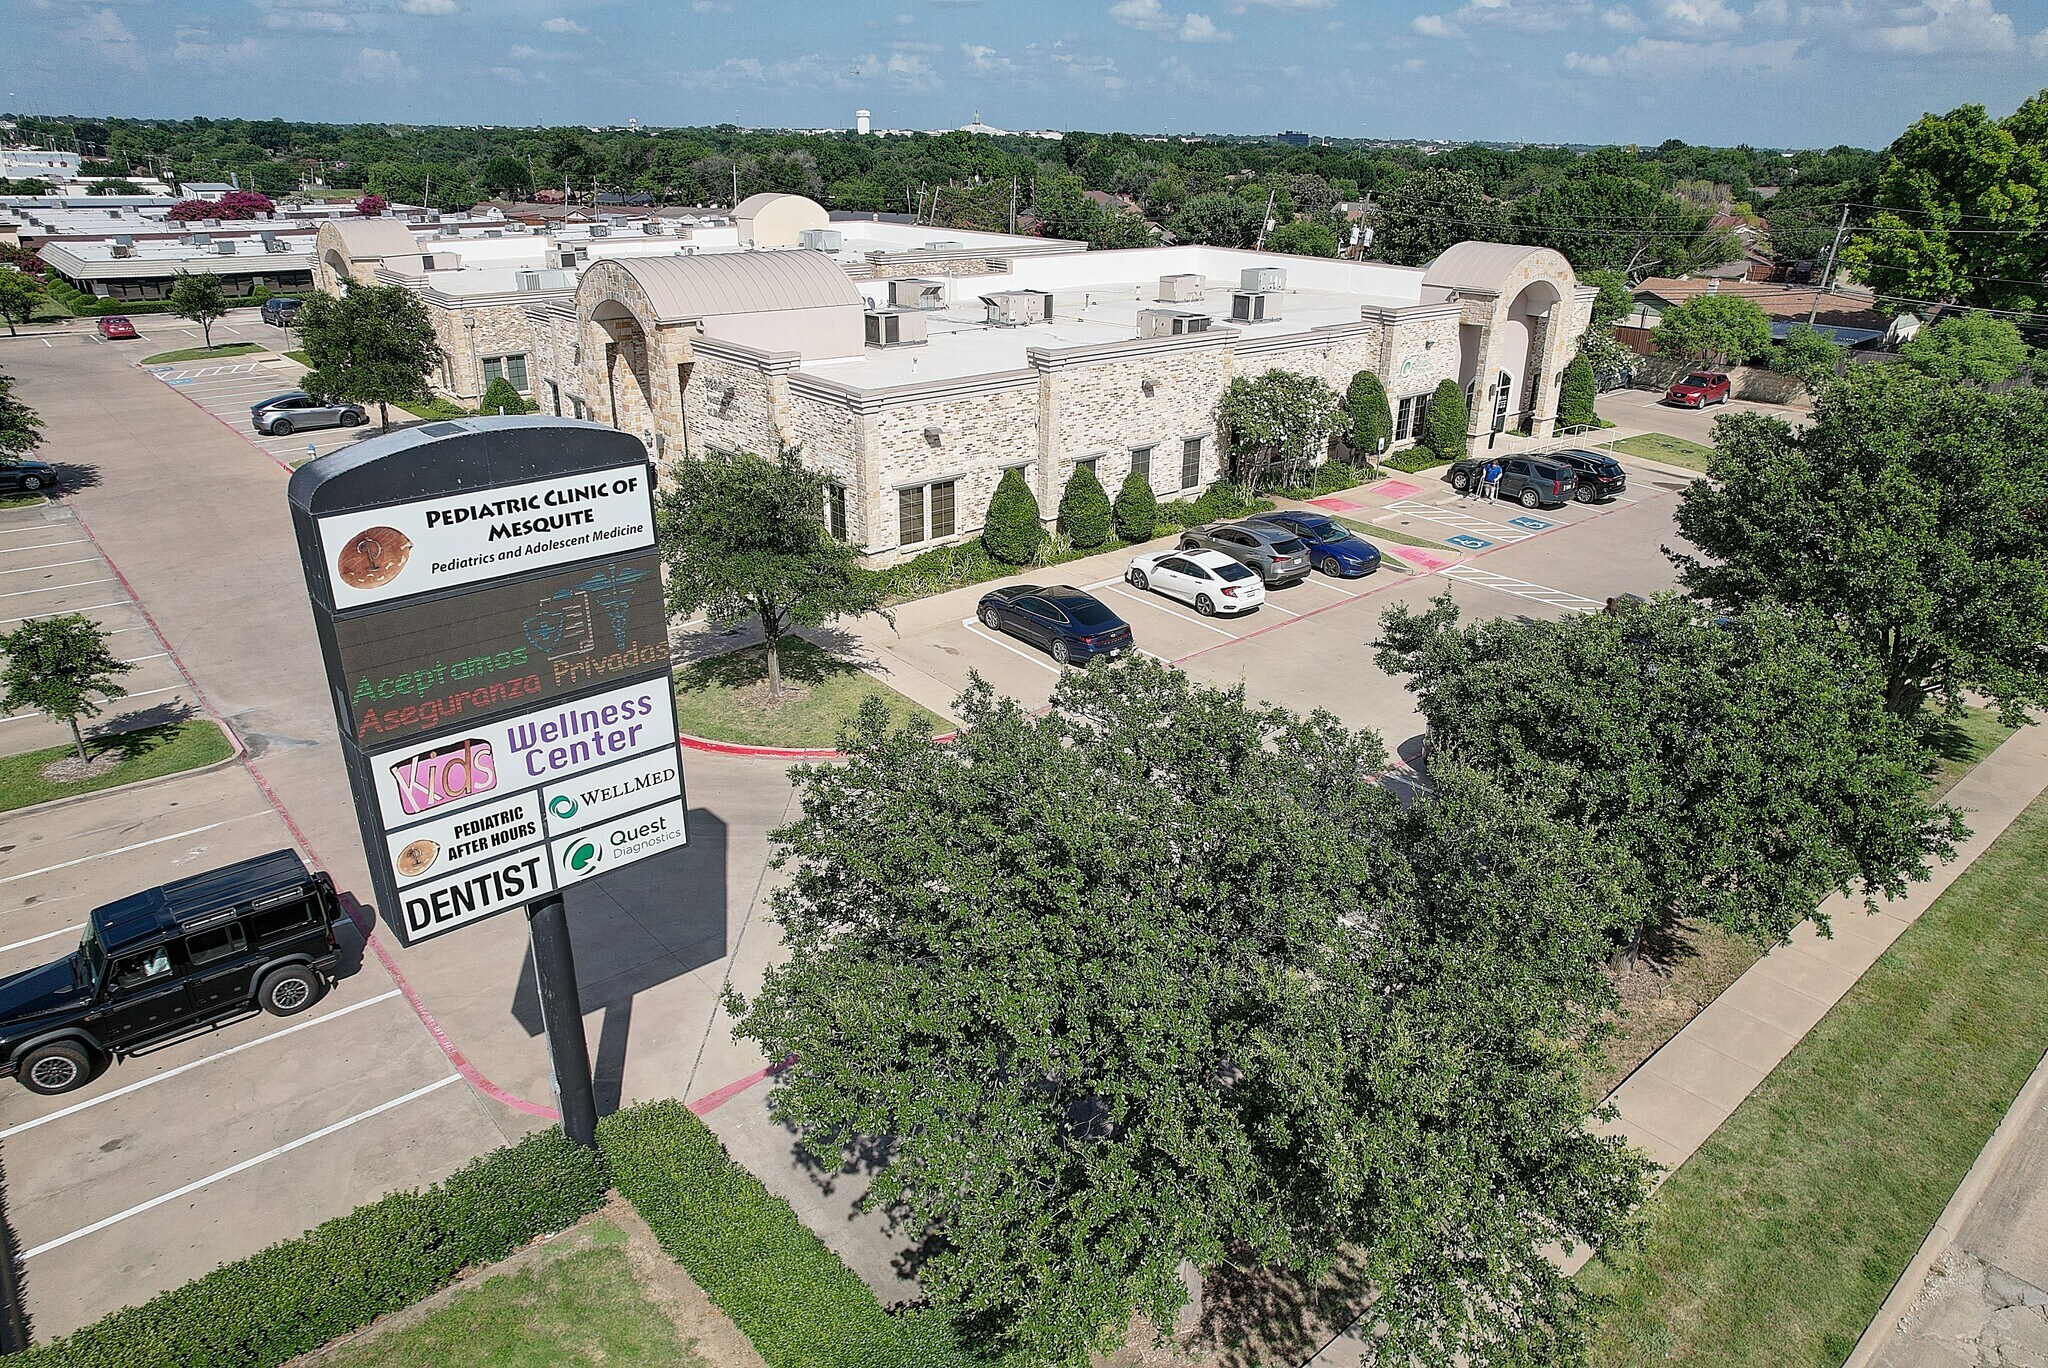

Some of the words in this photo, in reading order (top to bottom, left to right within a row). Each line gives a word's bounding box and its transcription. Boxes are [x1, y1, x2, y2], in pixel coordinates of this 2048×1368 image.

[426, 495, 540, 528] PEDIATRIC
[544, 483, 609, 506] CLINIC
[612, 478, 637, 494] OF
[488, 509, 594, 541] MESQUITE
[432, 554, 495, 574] Pediatrics
[498, 546, 521, 560] and
[525, 534, 590, 555] Adolescent
[593, 525, 643, 542] Medicine
[353, 645, 528, 706] Aceptamos
[359, 674, 541, 738] Aseguranza
[553, 640, 670, 685] Privadas
[508, 696, 651, 752] Wellness
[526, 725, 642, 775] Center
[391, 739, 493, 813] Kids
[449, 837, 488, 861] AFTER
[491, 822, 536, 847] HOURS
[454, 807, 523, 839] PEDIATRIC
[610, 817, 668, 846] Quest
[614, 830, 681, 858] Diagnostics
[406, 857, 540, 932] DENTIST
